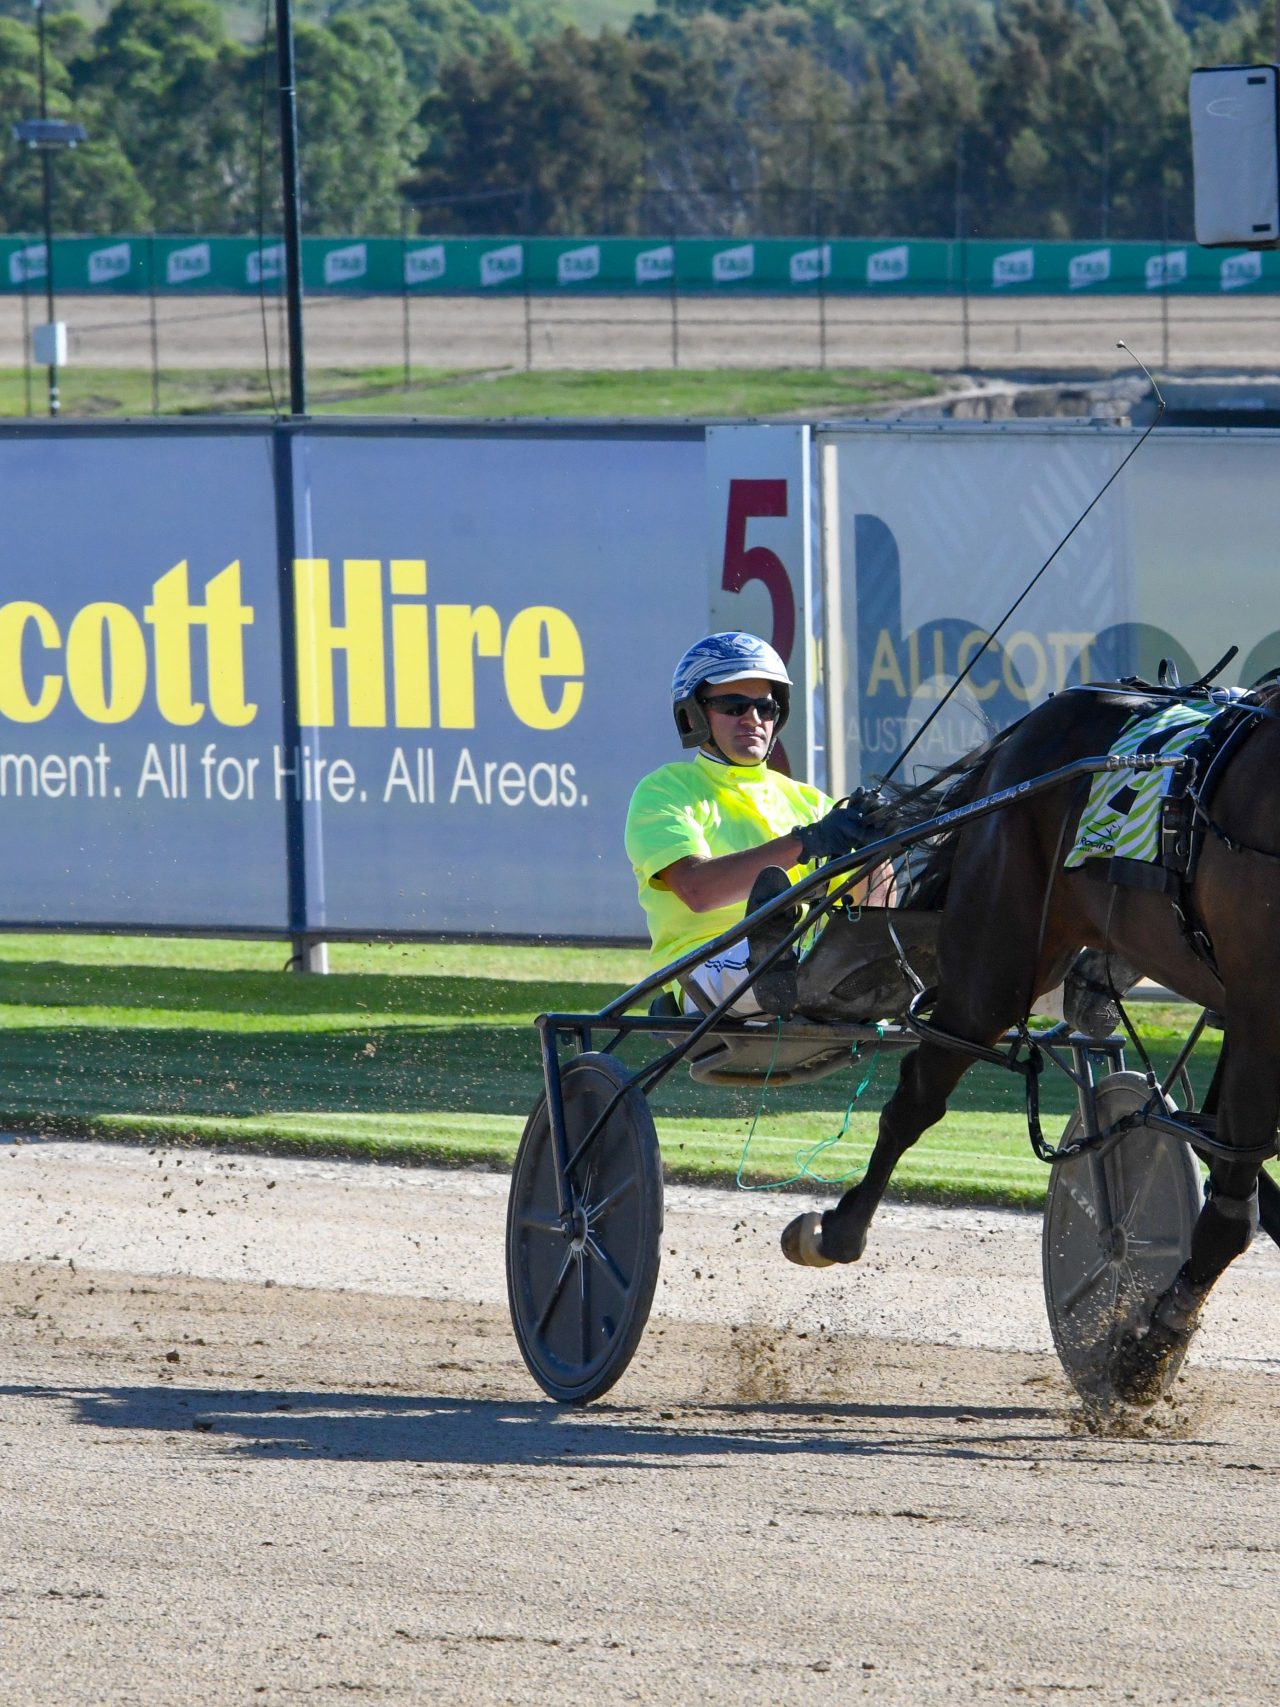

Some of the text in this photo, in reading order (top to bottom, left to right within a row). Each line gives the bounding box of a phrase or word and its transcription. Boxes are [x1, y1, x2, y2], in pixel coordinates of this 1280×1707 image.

[721, 479, 796, 672] 5
[293, 558, 586, 731] Hire
[866, 628, 1098, 701] ALLCOTT
[0, 743, 588, 807] ment. All for Hire. All Areas.
